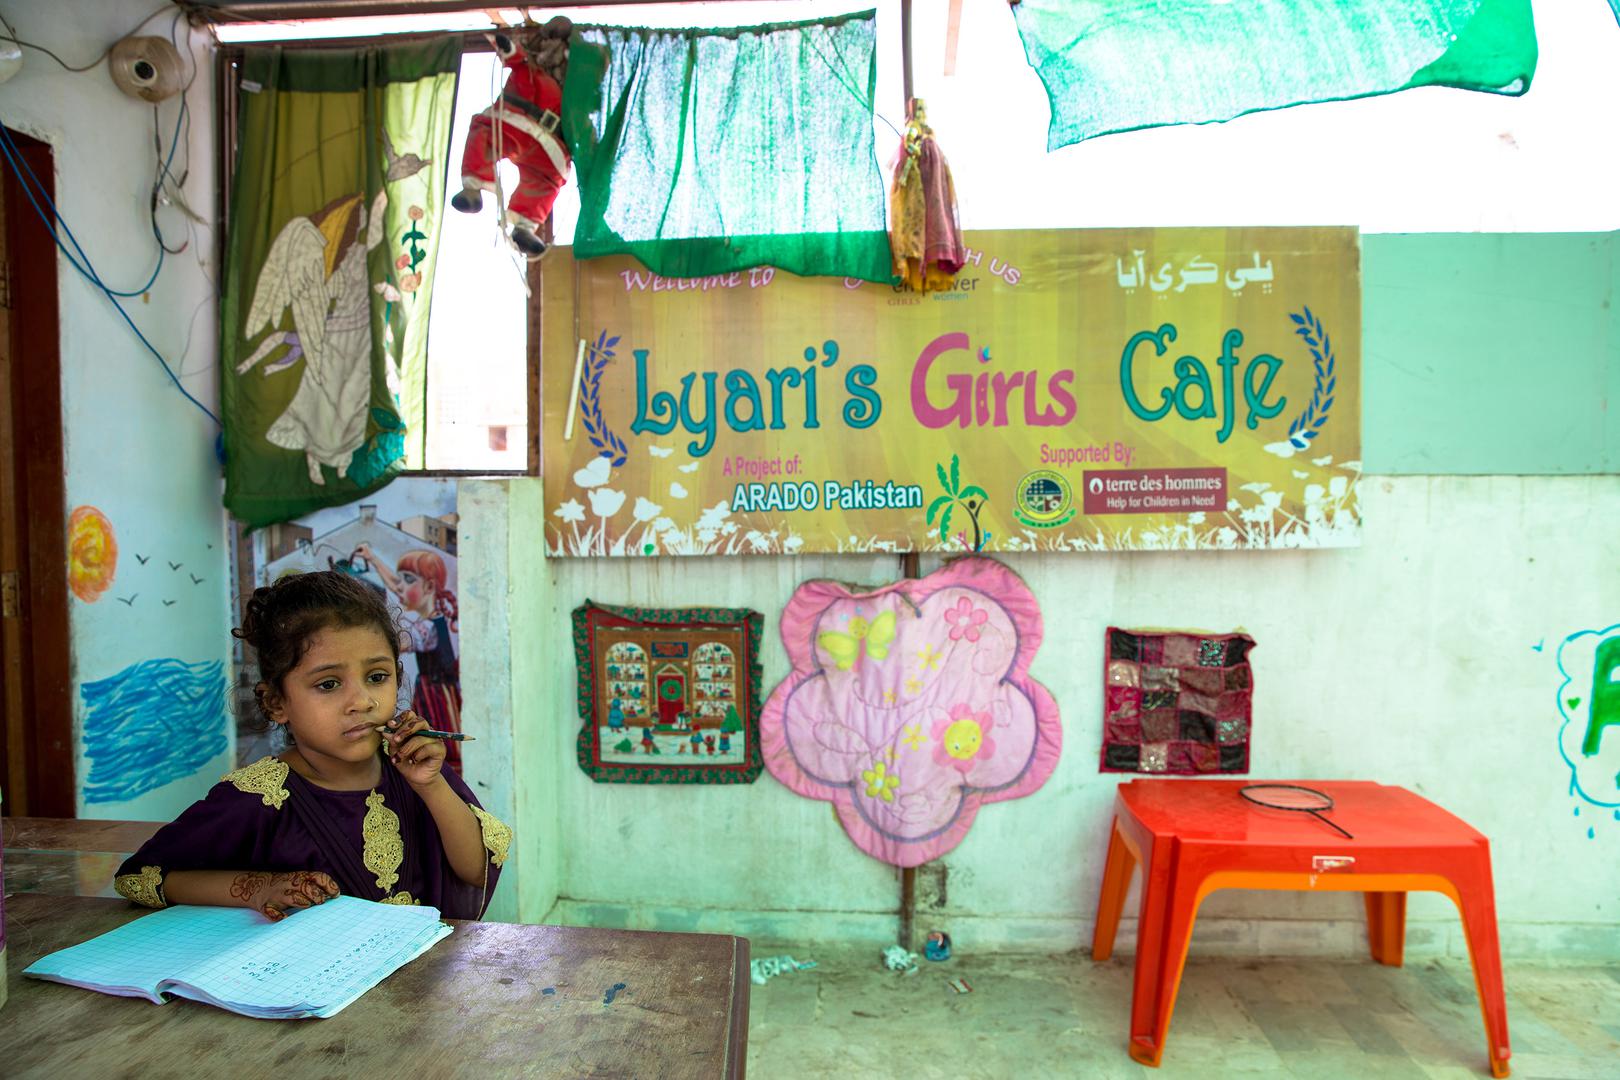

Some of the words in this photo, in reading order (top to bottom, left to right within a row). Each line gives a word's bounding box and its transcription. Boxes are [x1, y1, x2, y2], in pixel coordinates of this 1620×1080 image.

[748, 266, 775, 289] to
[989, 257, 1022, 285] US
[630, 339, 882, 458] Lyari's
[910, 331, 1078, 430] Girls
[1119, 322, 1287, 444] Cafe
[722, 456, 733, 476] A
[735, 456, 782, 480] Project
[785, 454, 802, 475] of:
[1040, 443, 1110, 468] Supported
[1113, 441, 1137, 467] By:
[731, 481, 819, 512] ARADO
[823, 480, 924, 510] Pakistan
[1105, 477, 1138, 493] terre
[1140, 475, 1163, 492] des
[1165, 474, 1222, 491] hommes
[1106, 497, 1126, 510] Help
[1128, 496, 1141, 507] for
[1143, 495, 1180, 507] Children
[1181, 495, 1190, 506] in
